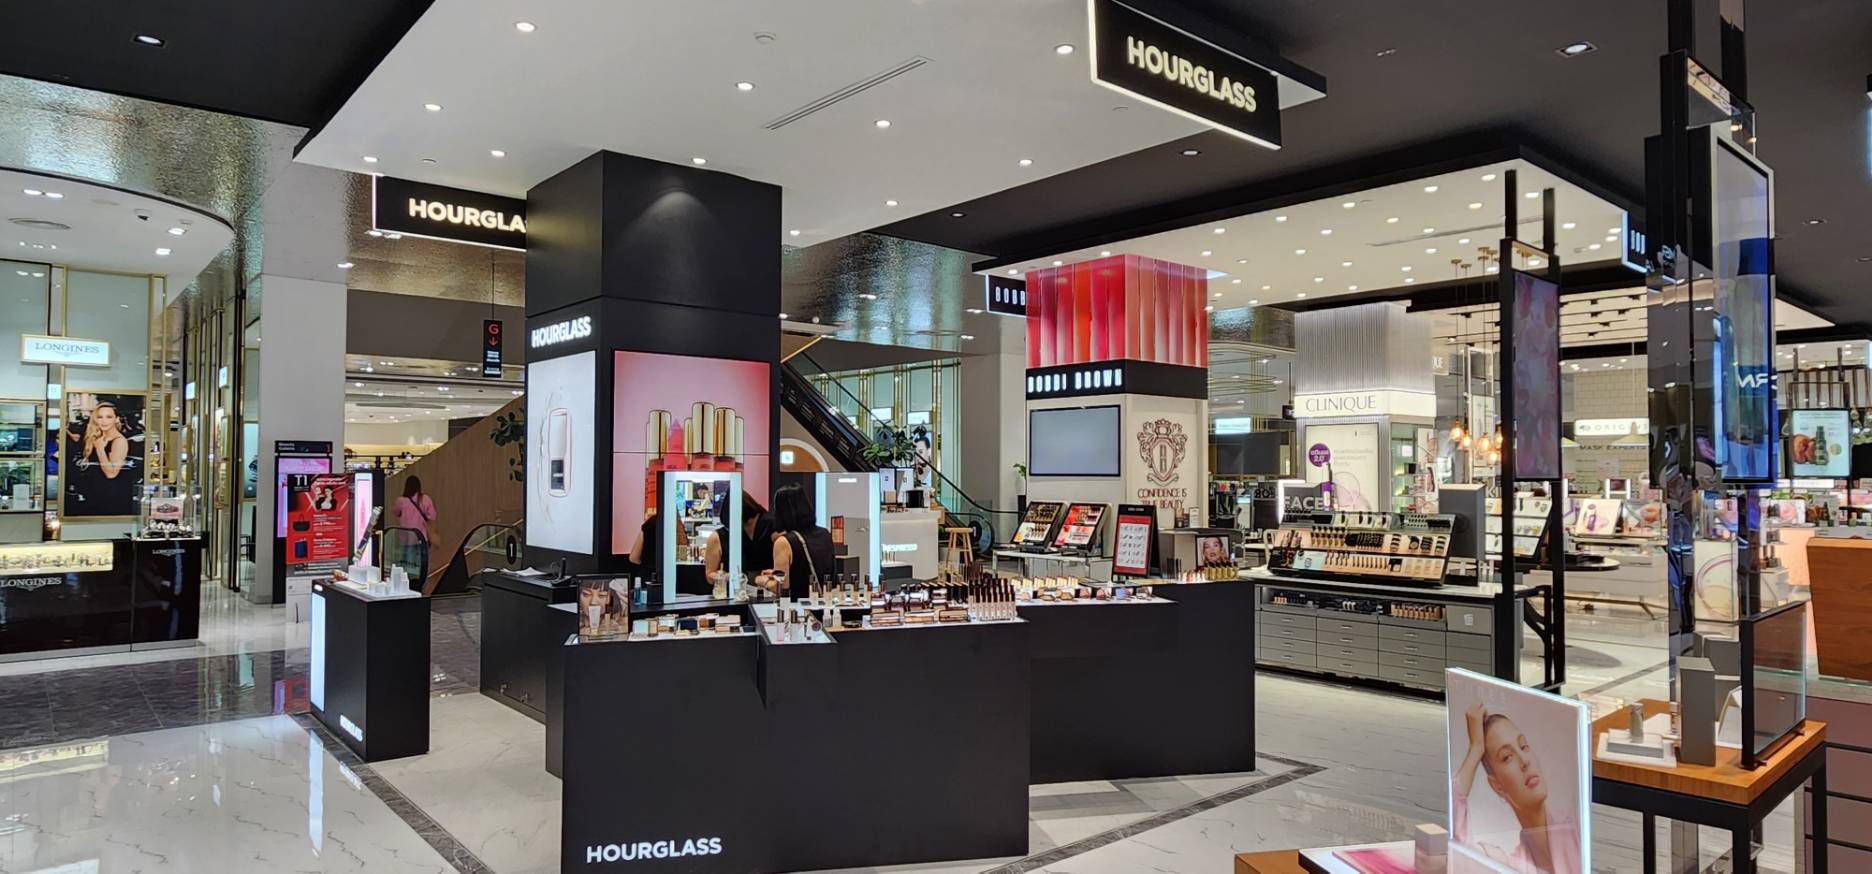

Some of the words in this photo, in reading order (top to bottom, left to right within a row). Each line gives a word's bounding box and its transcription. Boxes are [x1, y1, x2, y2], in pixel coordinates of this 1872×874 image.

[1126, 35, 1257, 113] HOURGLASS
[409, 198, 527, 233] HOURGLA
[488, 323, 499, 334] G
[531, 315, 592, 348] HOURGLASS
[34, 342, 100, 354] LONGINES
[1027, 373, 1067, 393] BOBBI
[1074, 368, 1122, 390] BROWN
[1305, 395, 1377, 412] CLINIQUE
[1137, 488, 1180, 498] CONFIDENCE
[1181, 488, 1187, 498] IS
[0, 577, 62, 587] LONGINES
[586, 836, 722, 863] HOURGLASS
